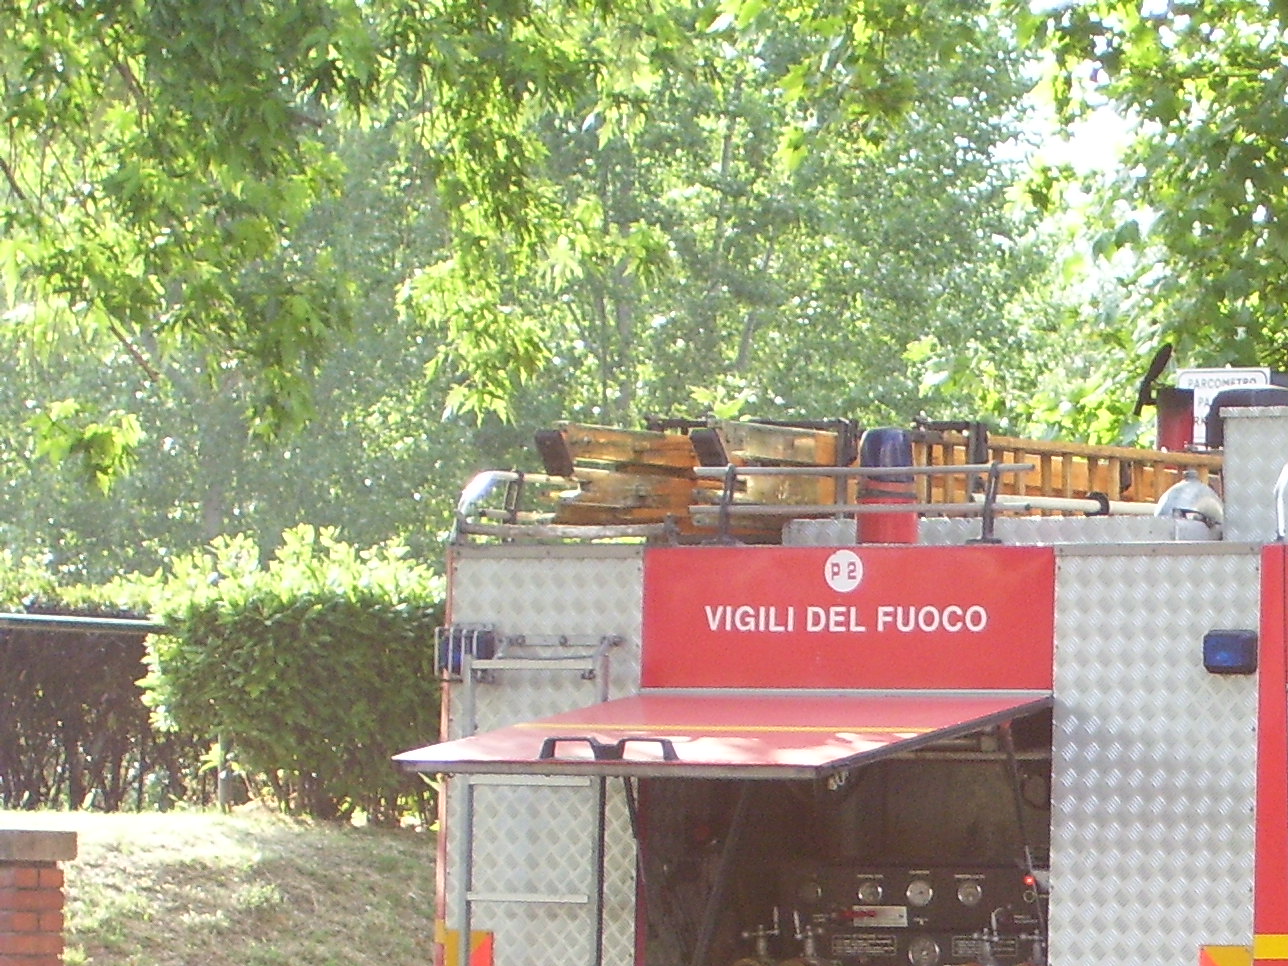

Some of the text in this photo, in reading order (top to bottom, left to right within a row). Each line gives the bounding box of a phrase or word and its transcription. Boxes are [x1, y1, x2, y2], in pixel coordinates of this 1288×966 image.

[704, 604, 988, 633] VIGILI DEL FUOCO
